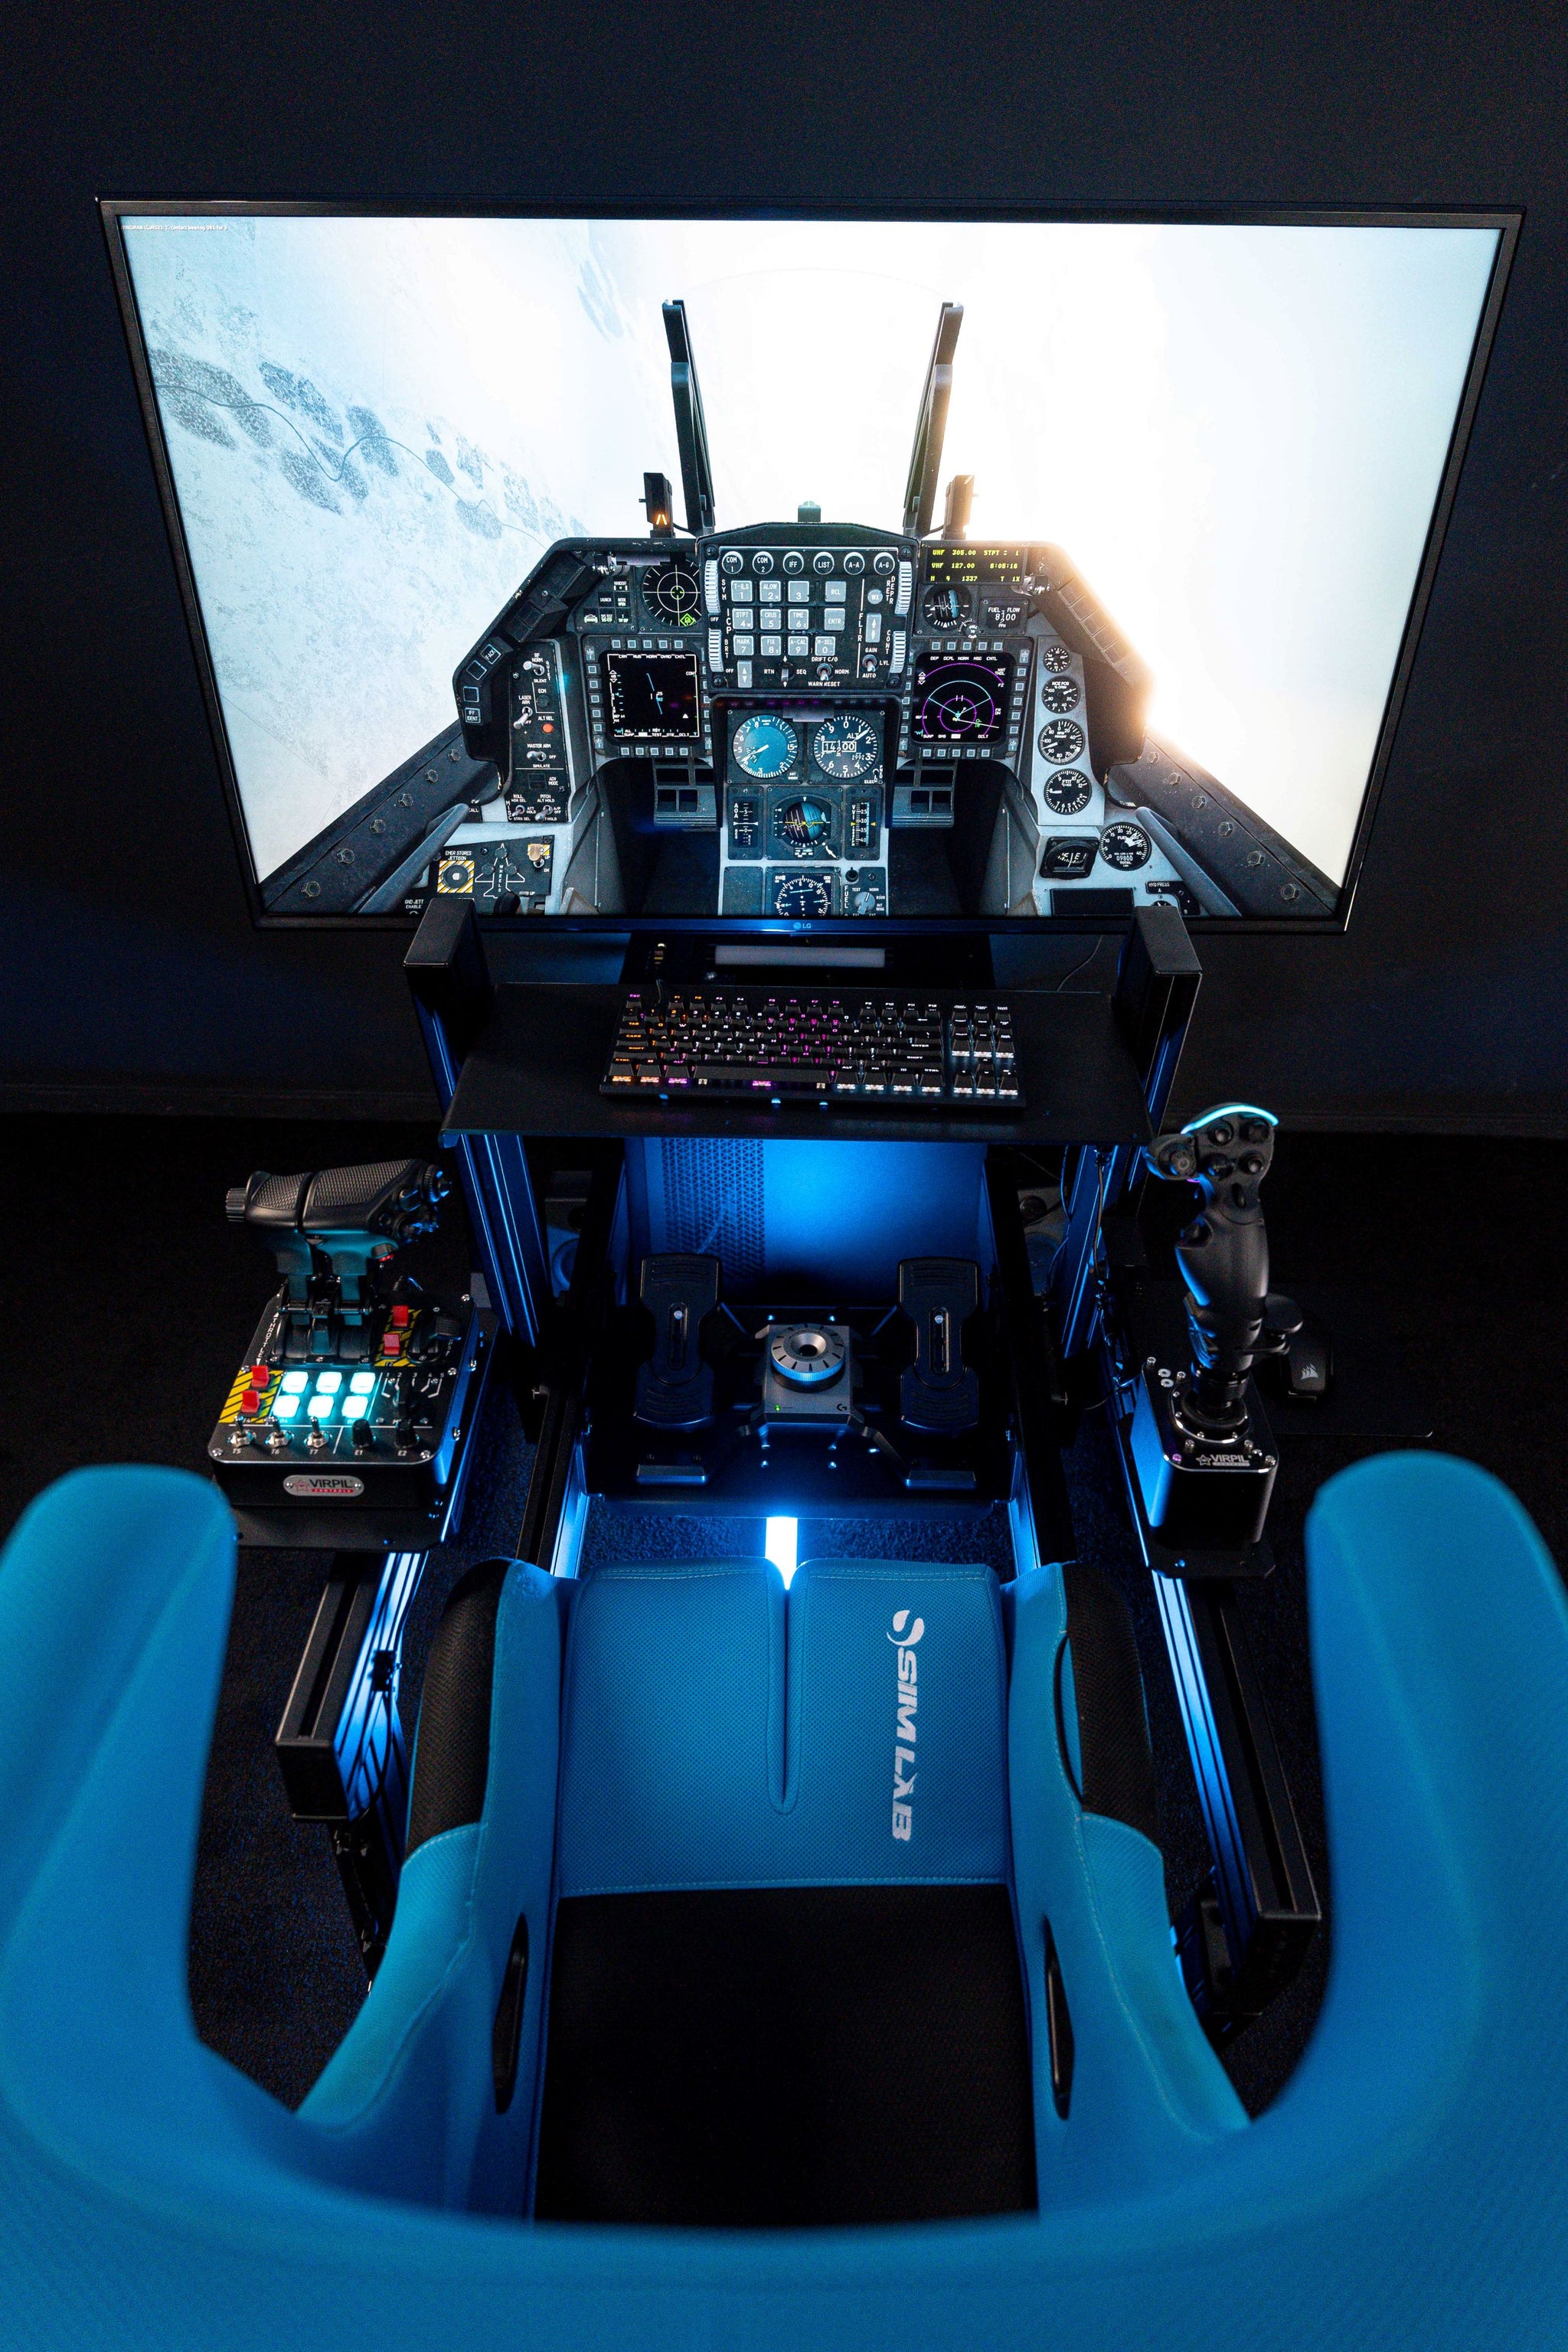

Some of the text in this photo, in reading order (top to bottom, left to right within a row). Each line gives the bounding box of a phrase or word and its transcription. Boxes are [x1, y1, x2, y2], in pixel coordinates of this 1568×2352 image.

[258, 1318, 278, 1357] THROTTLE
[1210, 1454, 1250, 1462] VIRPIL
[309, 1478, 353, 1488] VIRPIL
[897, 1647, 917, 1743] SIM
